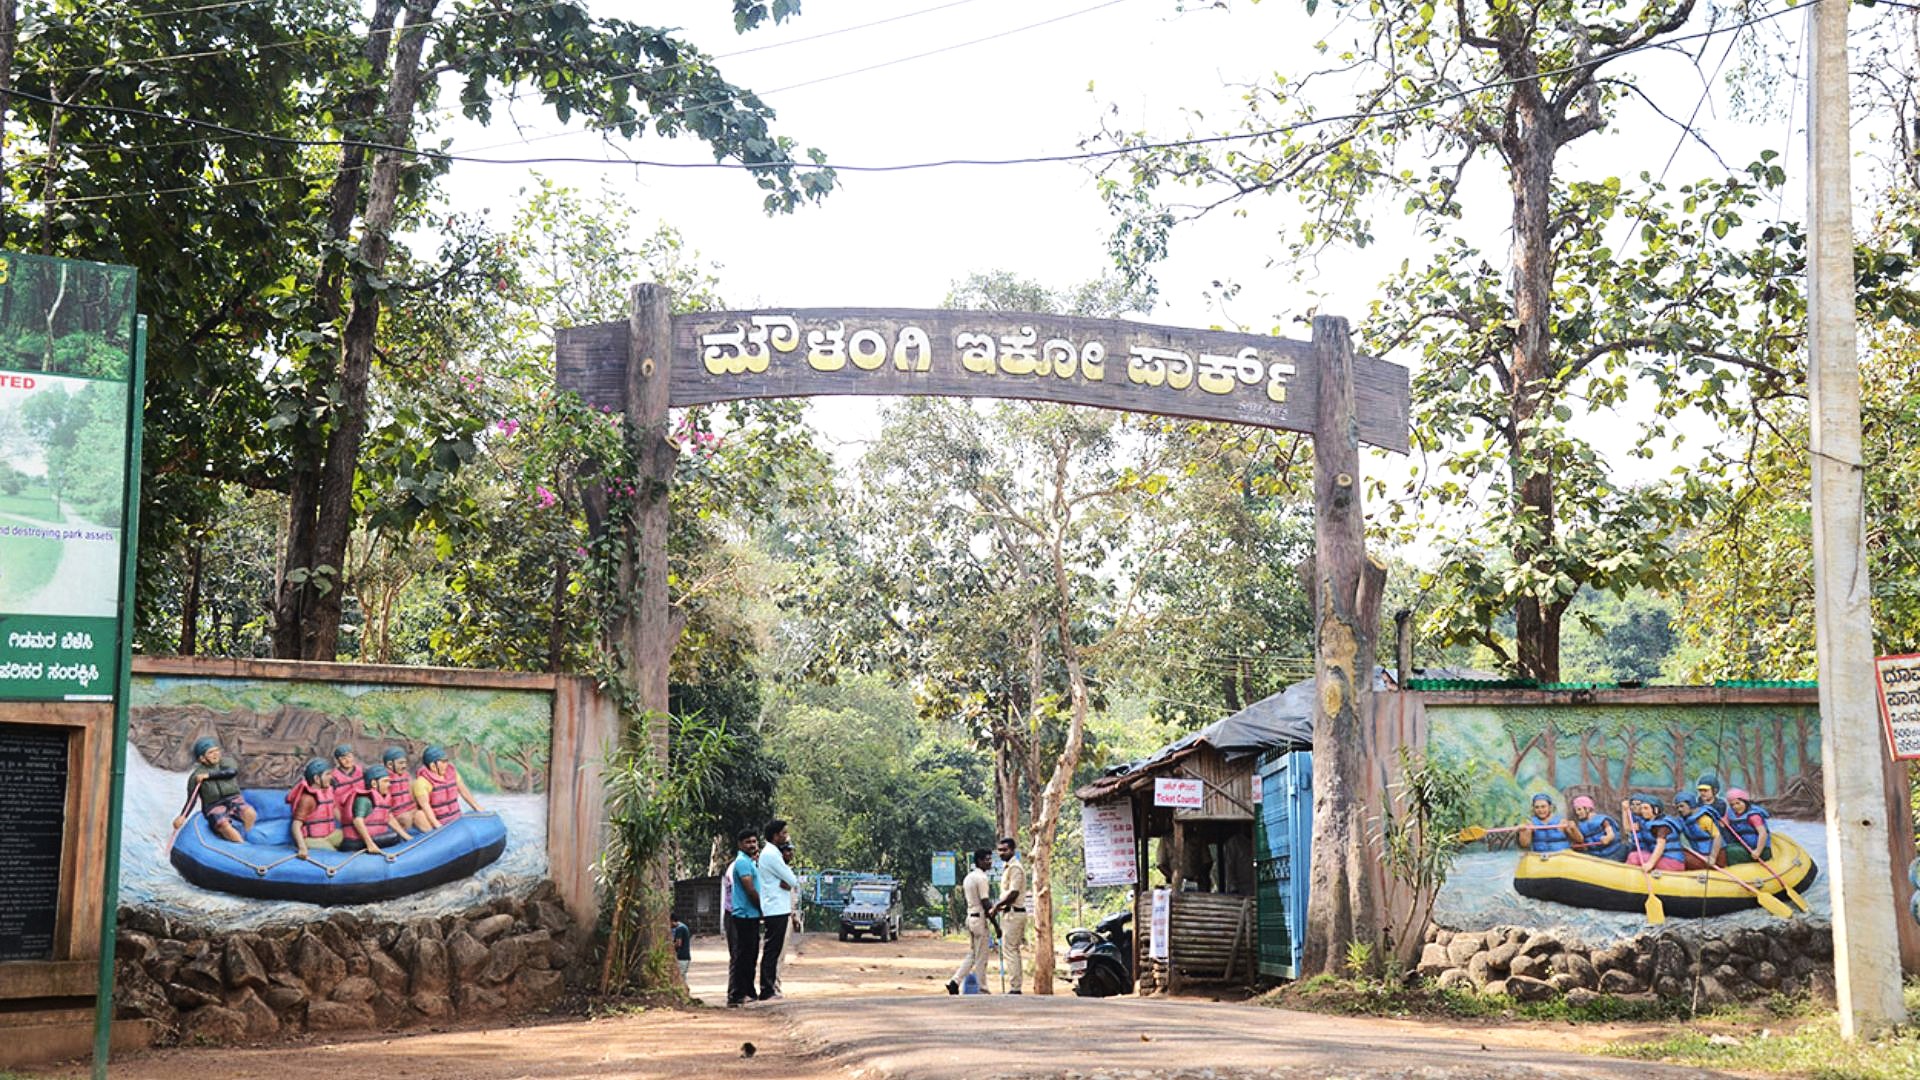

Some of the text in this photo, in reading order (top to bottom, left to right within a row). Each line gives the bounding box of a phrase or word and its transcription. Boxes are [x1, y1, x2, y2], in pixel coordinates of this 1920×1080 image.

[956, 326, 1105, 381] ಇಕೋ
[1127, 345, 1296, 402] ಪಾರ್ಕ್
[12, 526, 60, 539] destroying
[63, 529, 83, 540] park
[85, 531, 113, 540] assets
[9, 631, 56, 649] ಗಿಡಮರ
[1156, 793, 1201, 804] Ticket Counter
